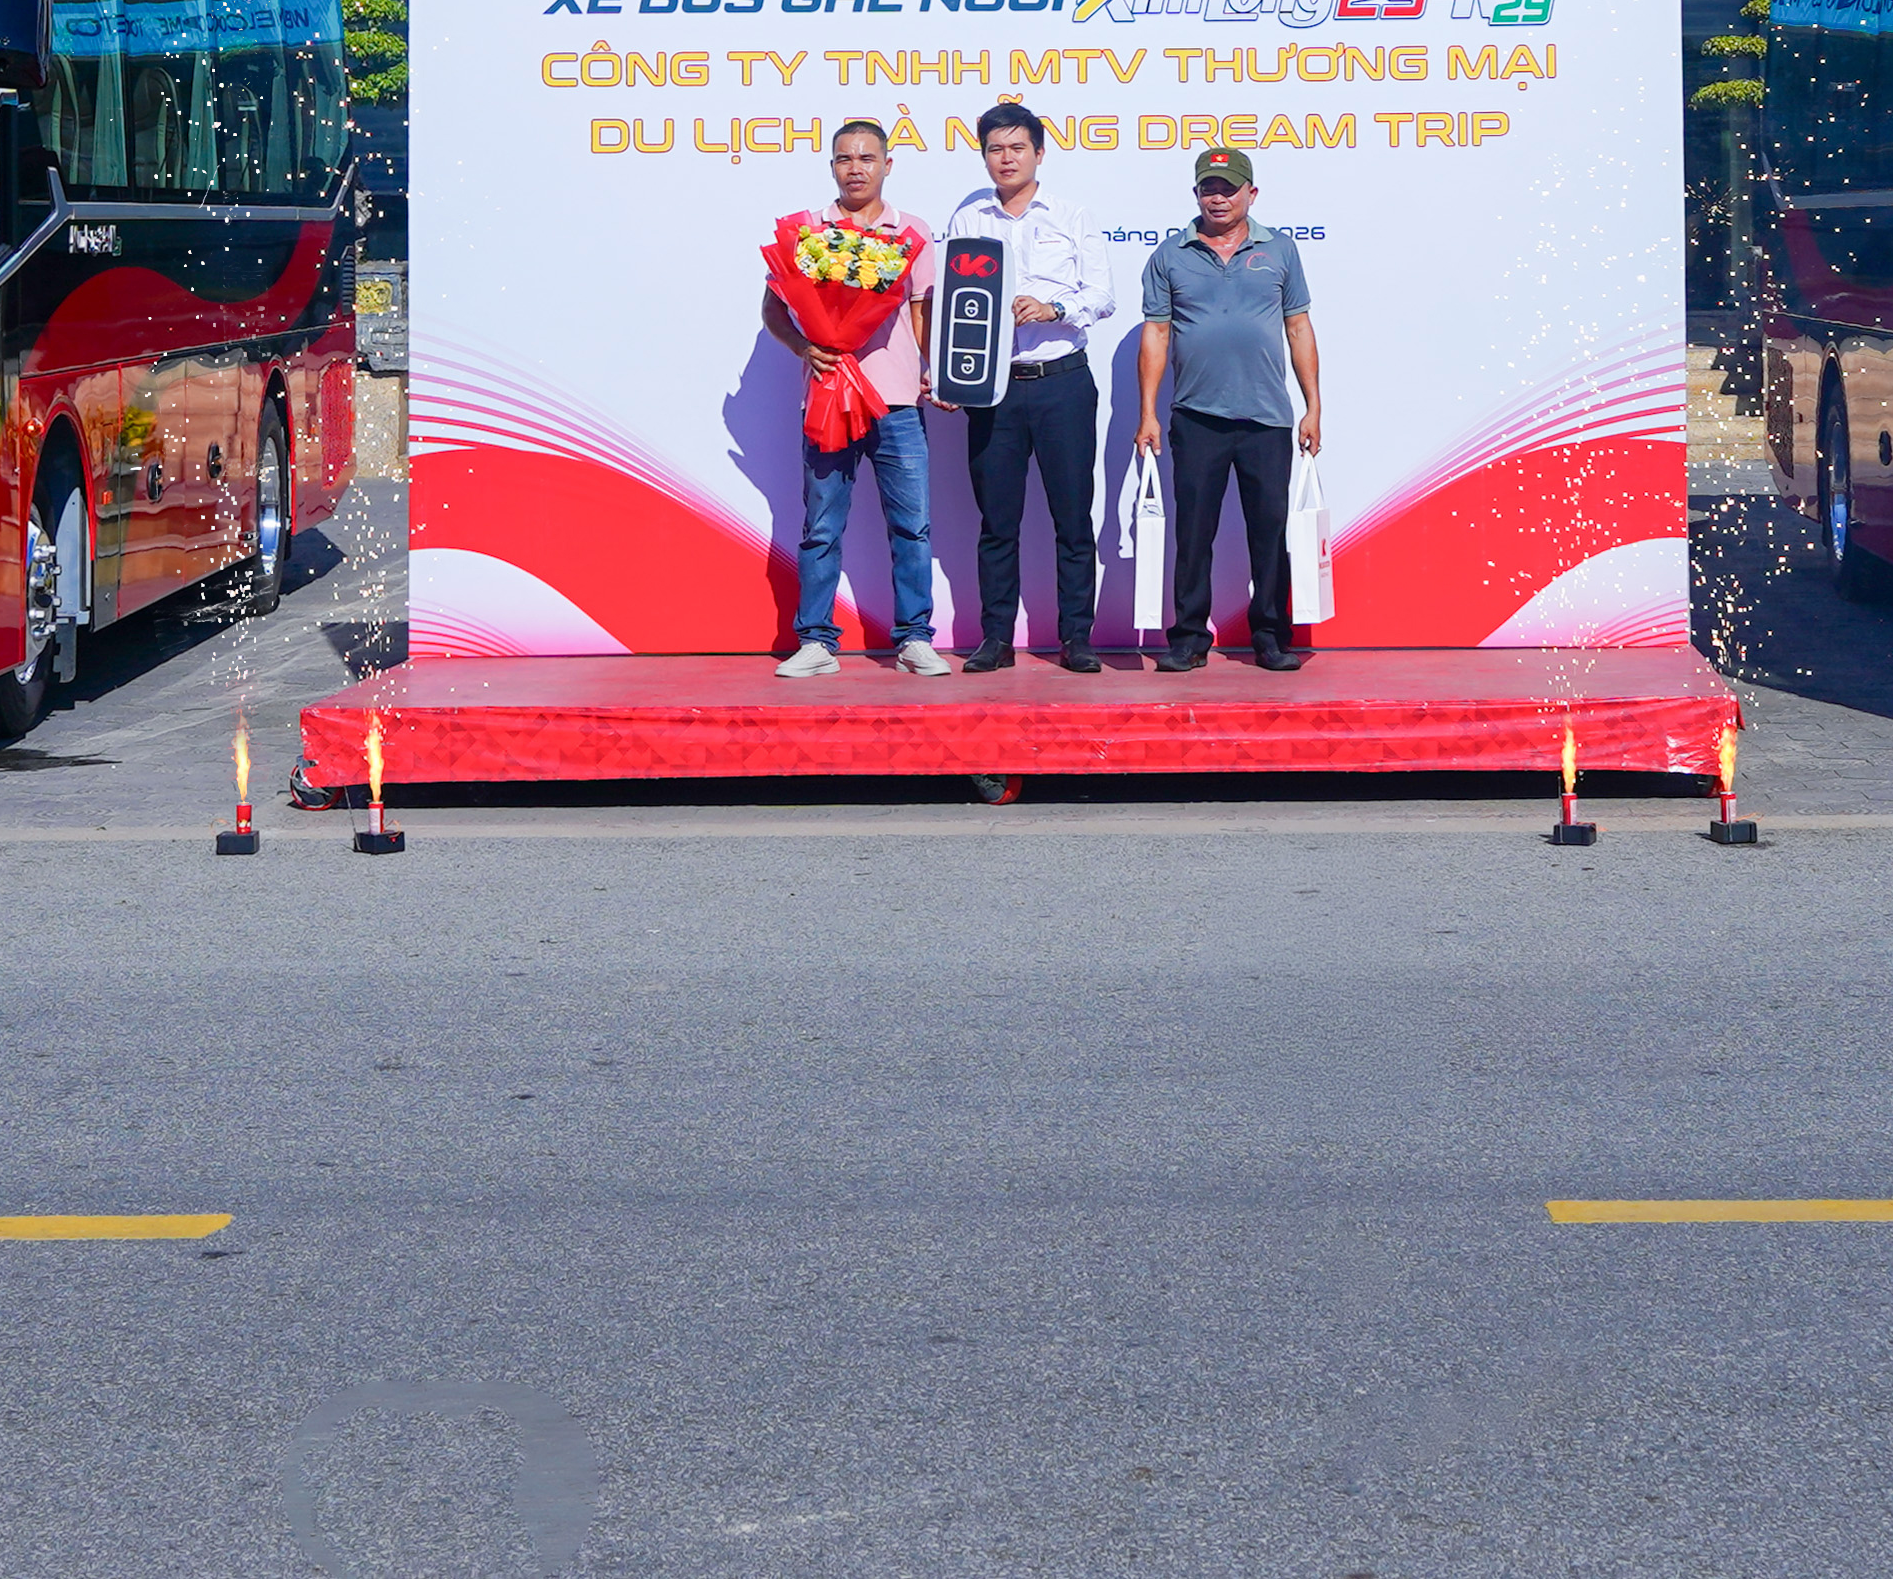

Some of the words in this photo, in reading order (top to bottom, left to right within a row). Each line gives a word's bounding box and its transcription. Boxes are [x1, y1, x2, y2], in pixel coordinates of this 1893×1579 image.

[541, 39, 710, 88] CÔNG
[726, 50, 809, 87] TY
[823, 49, 991, 86] TNHH
[1009, 48, 1148, 85] MTV
[1162, 41, 1429, 84] THƯƠNG
[1447, 43, 1557, 94] MẠI
[590, 117, 675, 154] DU
[693, 116, 822, 166] LỊCH
[843, 103, 928, 152] À
[945, 93, 1120, 152] NNG
[1137, 112, 1357, 151] DREAM
[1373, 110, 1510, 148] TRIP
[1267, 226, 1325, 240] 026
